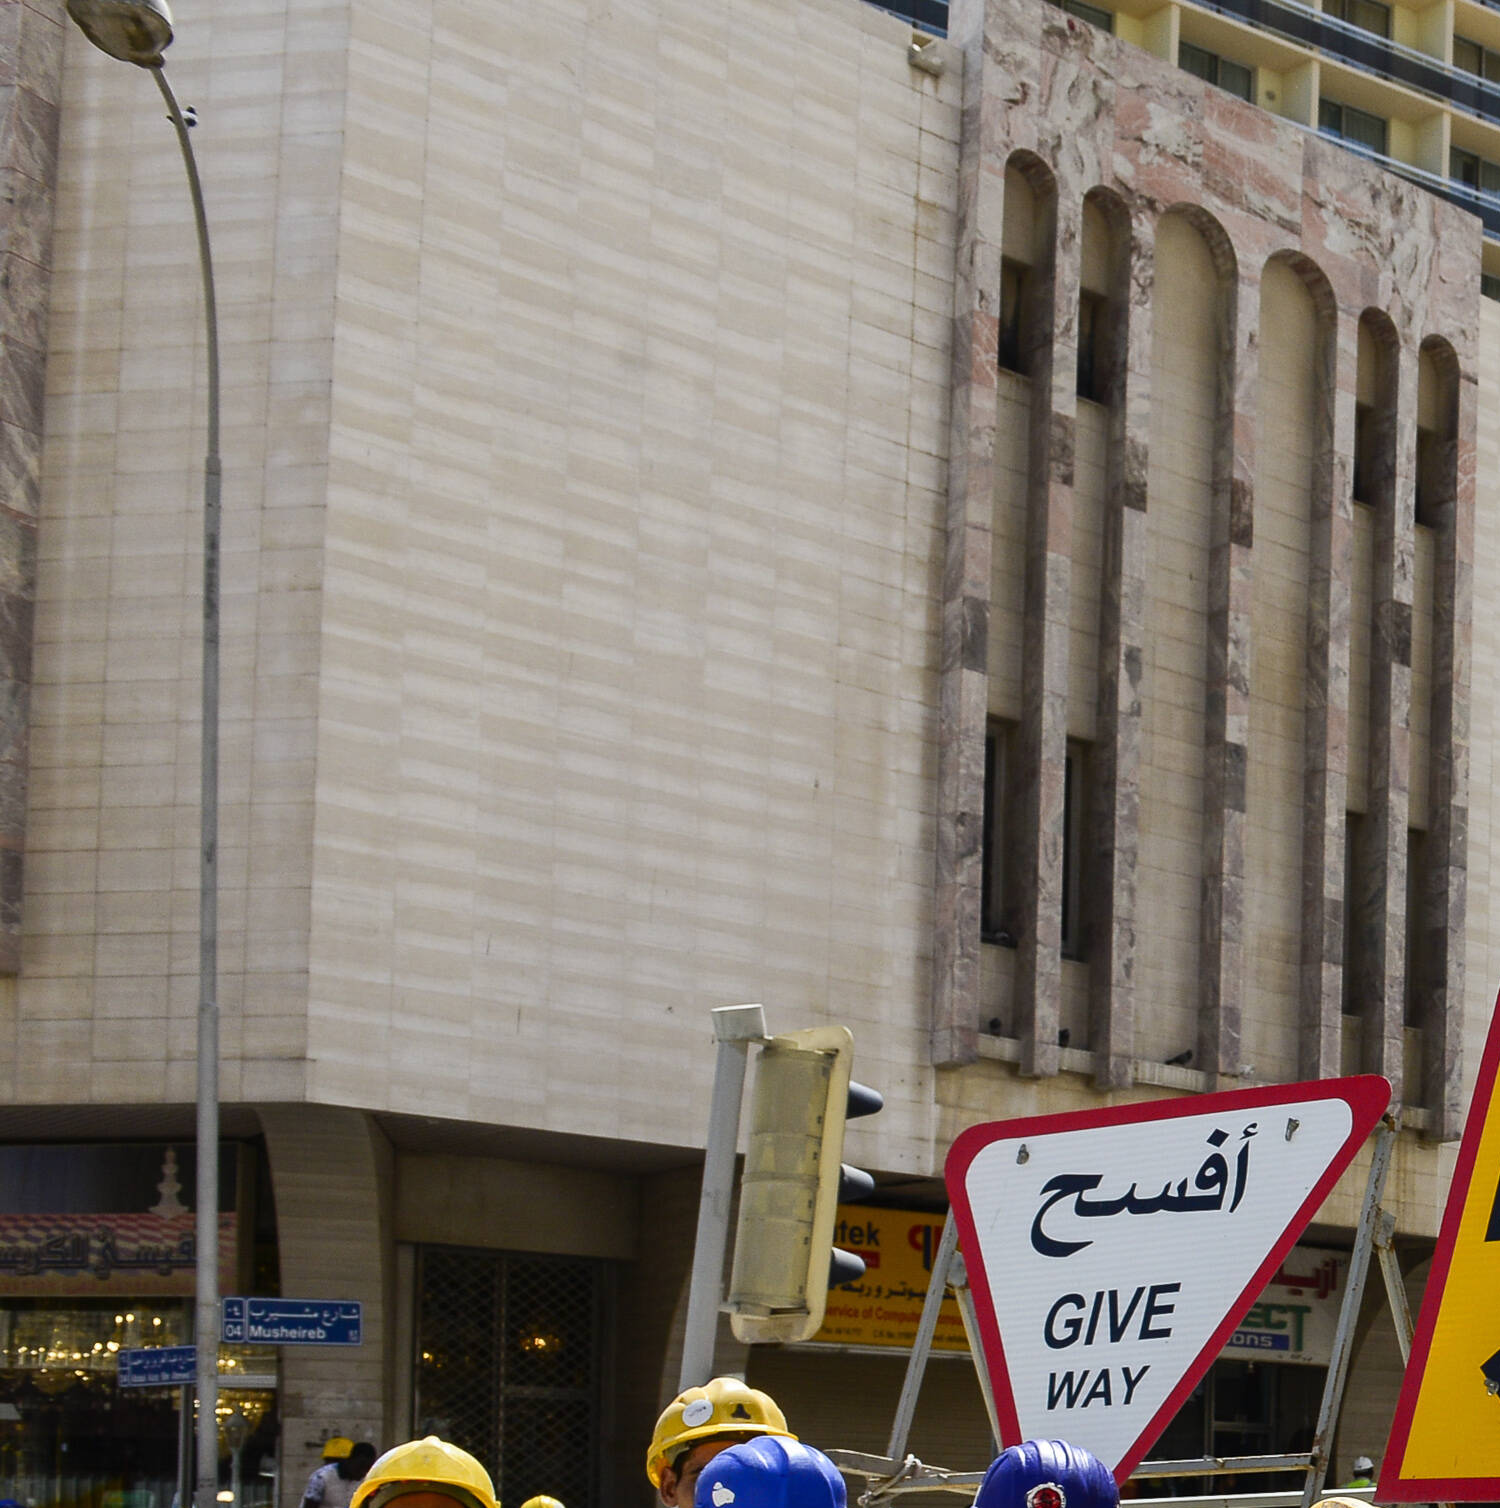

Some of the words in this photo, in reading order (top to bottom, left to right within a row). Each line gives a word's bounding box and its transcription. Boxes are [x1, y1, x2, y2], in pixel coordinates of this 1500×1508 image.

[1031, 1122, 1258, 1258] أفسح
[834, 1219, 881, 1246] tek
[321, 1306, 359, 1327] شارع
[1044, 1282, 1181, 1350] GIVE
[1240, 1302, 1312, 1351] ECT
[225, 1324, 242, 1338] 04
[249, 1325, 327, 1340] Musheireb
[1231, 1333, 1273, 1348] ons
[1047, 1365, 1151, 1410] WAY
